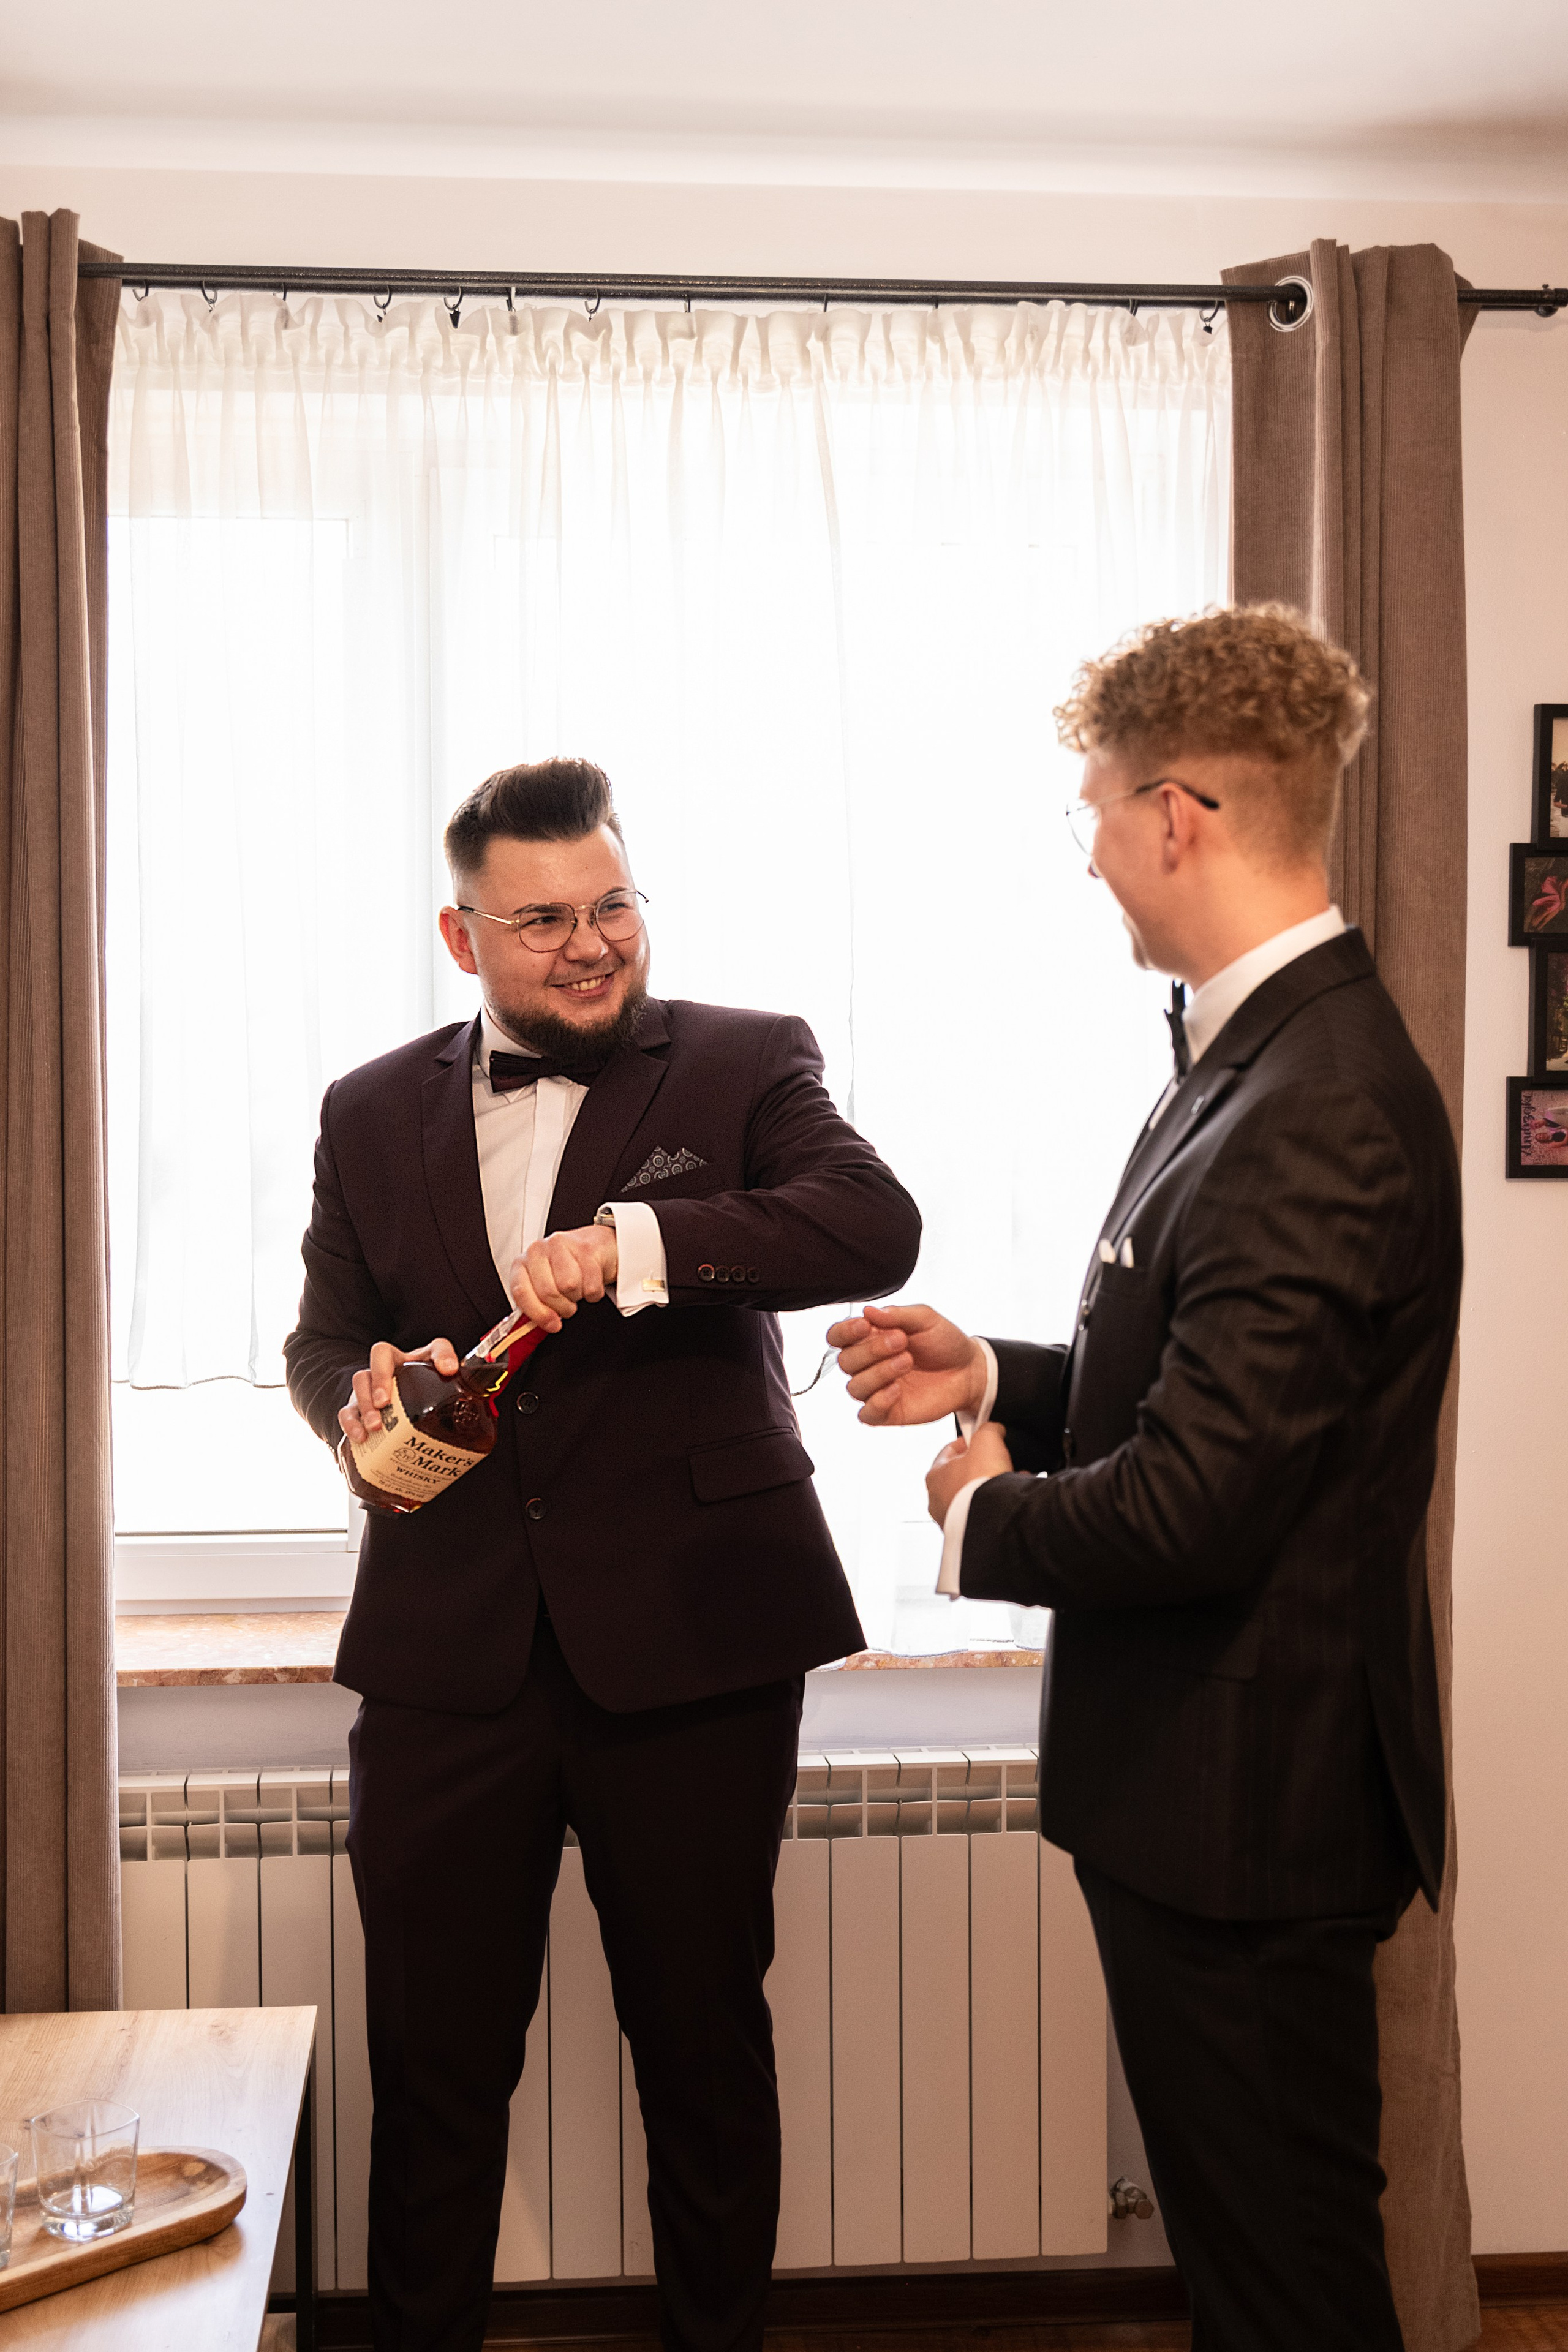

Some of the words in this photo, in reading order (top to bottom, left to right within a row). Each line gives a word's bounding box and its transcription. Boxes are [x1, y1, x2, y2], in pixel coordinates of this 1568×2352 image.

[404, 1436, 475, 1467] Maker's
[396, 1466, 441, 1484] WHISKY
[411, 1456, 461, 1477] Mark
